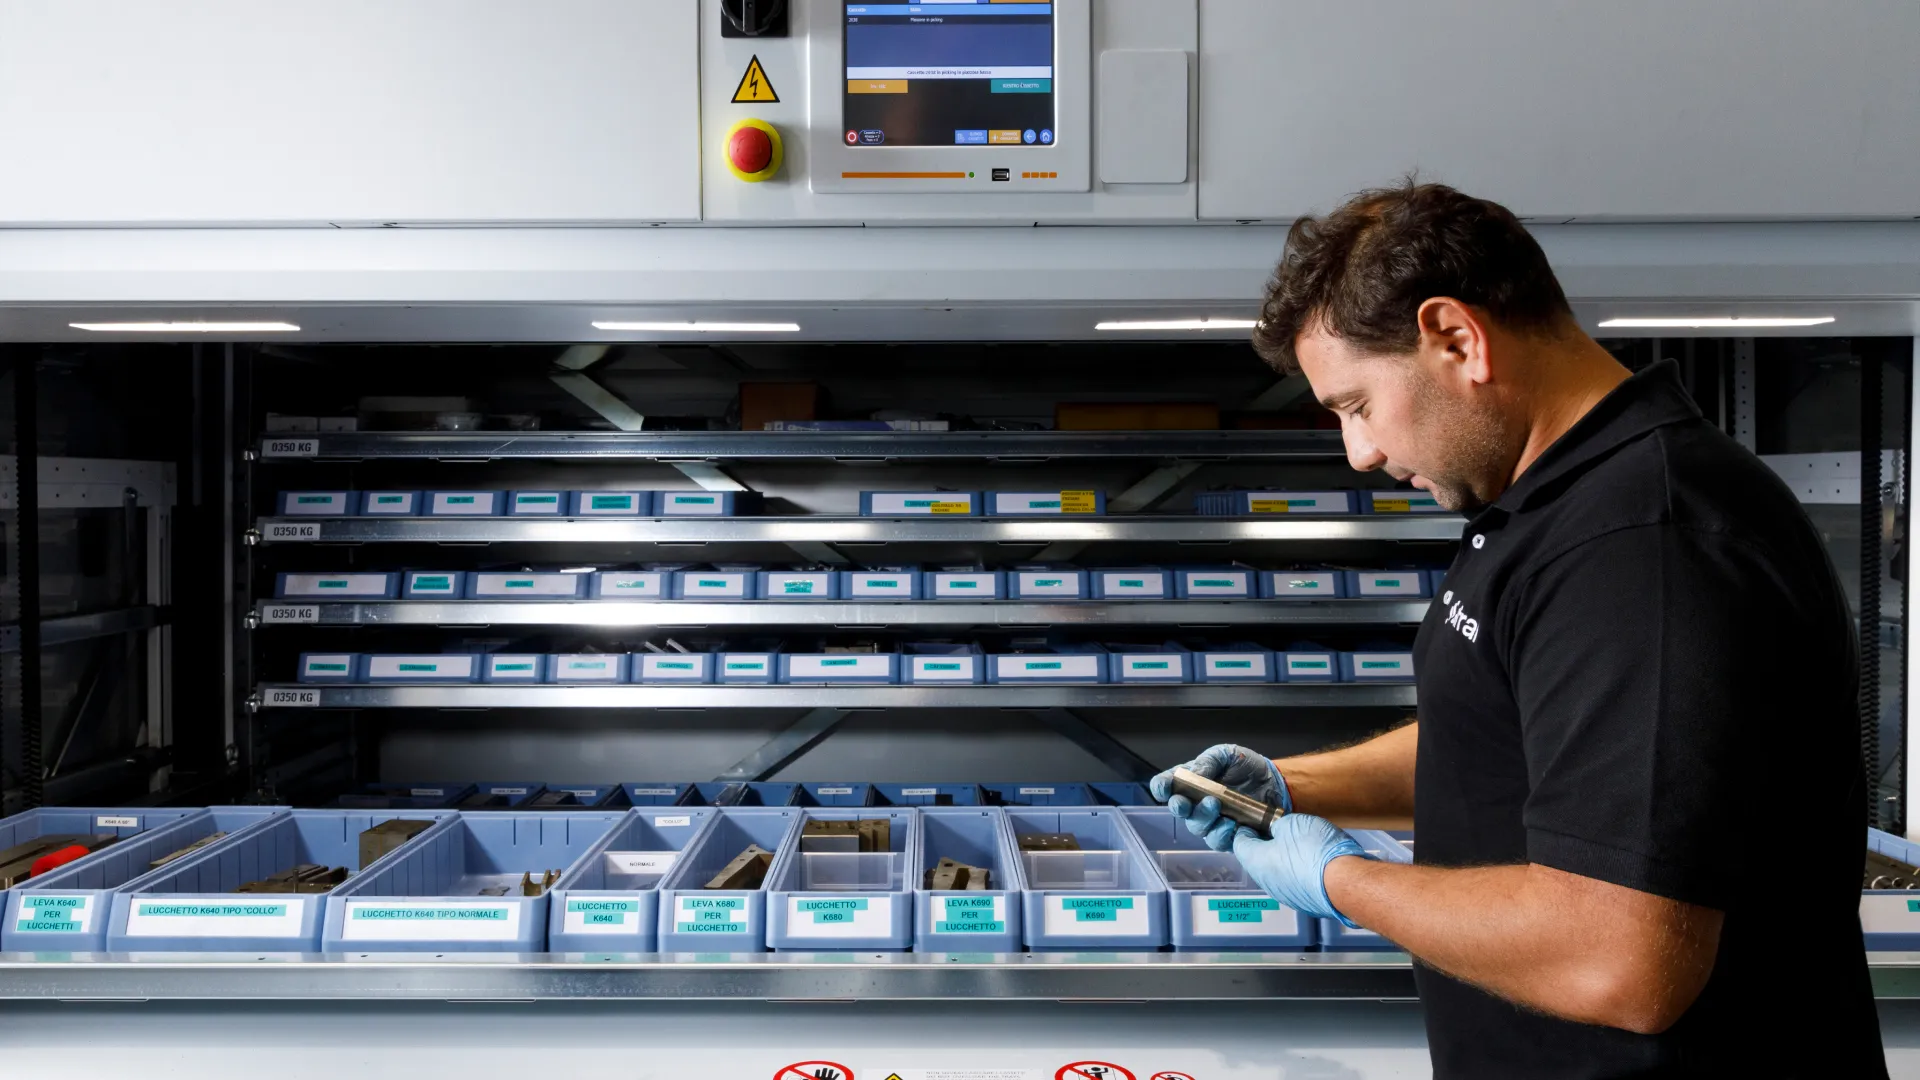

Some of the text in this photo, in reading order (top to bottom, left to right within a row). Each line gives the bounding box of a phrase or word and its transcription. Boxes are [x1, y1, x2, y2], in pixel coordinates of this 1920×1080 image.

[272, 442, 312, 452] 0350 KG
[273, 526, 313, 536] 0350 KG
[272, 609, 312, 618] 0350 KG
[273, 692, 313, 702] 0350 KG
[33, 898, 77, 907] LEVA K640
[577, 902, 627, 910] LUCCHETTO
[806, 901, 857, 909] LUCCHETTO
[947, 899, 969, 907] LEVA
[1071, 900, 1122, 908] LUCCHETTO
[1217, 901, 1268, 909] LUCCHETTO
[43, 910, 61, 918] PER
[148, 906, 198, 914] LUCCHETTO
[362, 910, 499, 918] LUCCHETTO K640 TIPO NORMALE
[593, 914, 613, 922] K640
[823, 913, 843, 921] K680
[961, 911, 978, 919] PER
[1085, 911, 1106, 919] K690
[27, 922, 74, 930] LUCCHETTI
[687, 924, 738, 932] LUCCHETTO
[945, 923, 996, 931] LUCCHETTO
